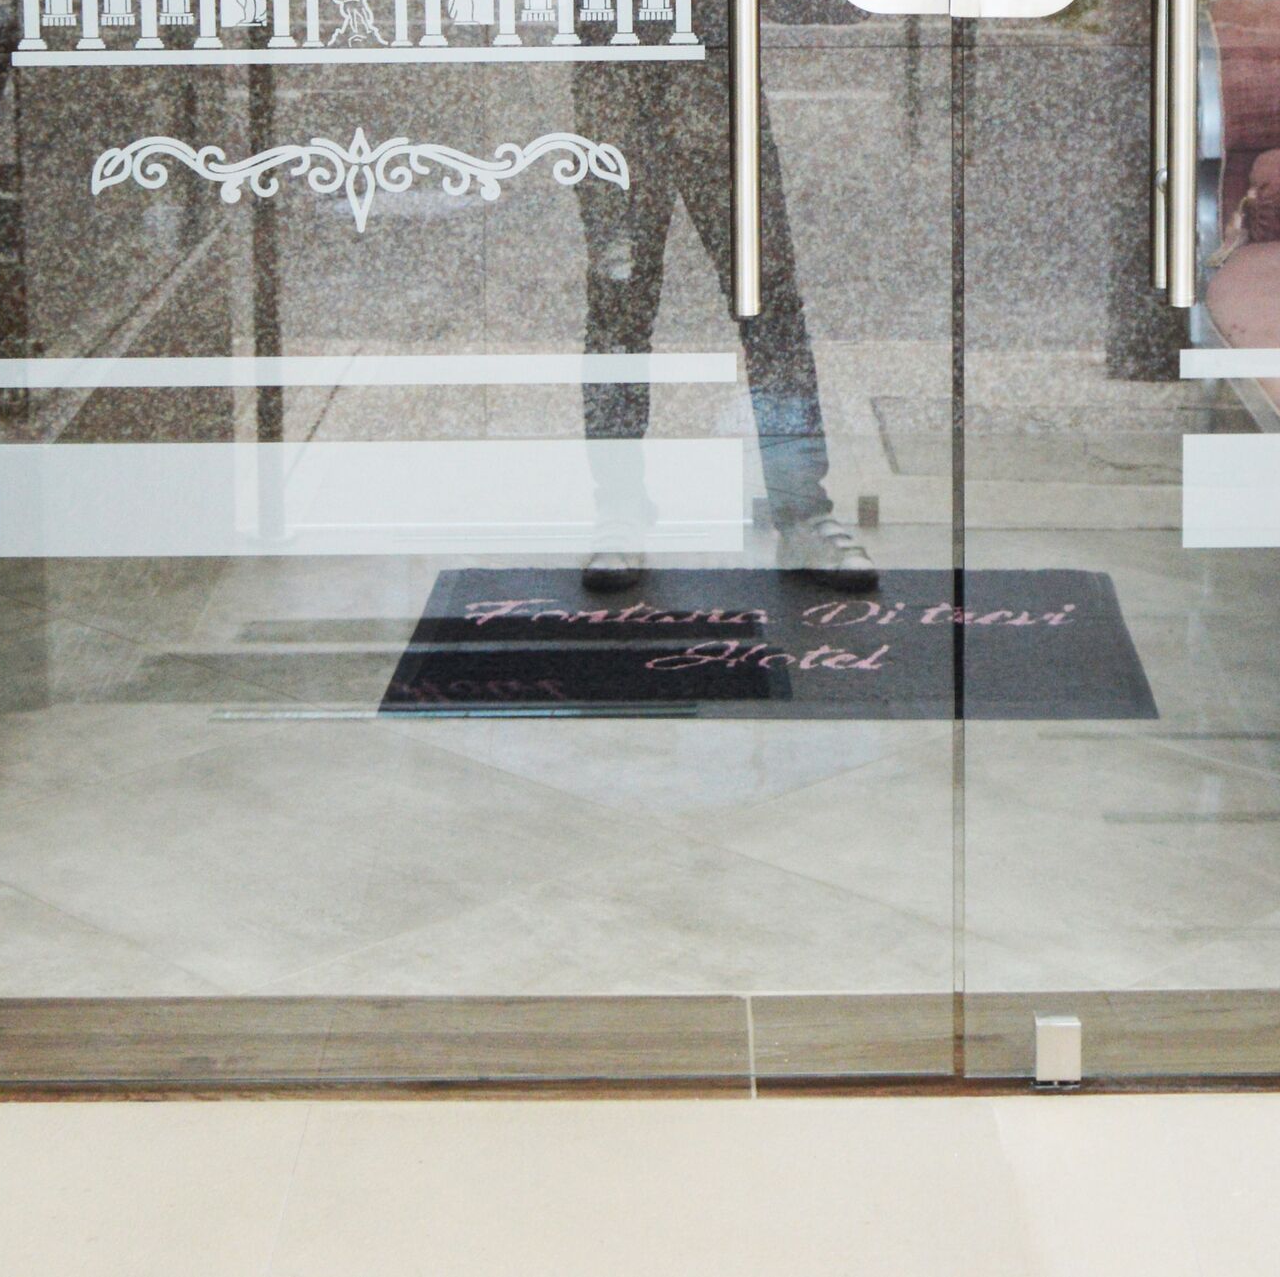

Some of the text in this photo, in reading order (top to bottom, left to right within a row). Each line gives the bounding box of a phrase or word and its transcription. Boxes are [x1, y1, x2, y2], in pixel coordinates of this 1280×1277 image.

[465, 599, 769, 626] Fontana
[801, 600, 905, 627] Di
[645, 640, 890, 671] Hotel
